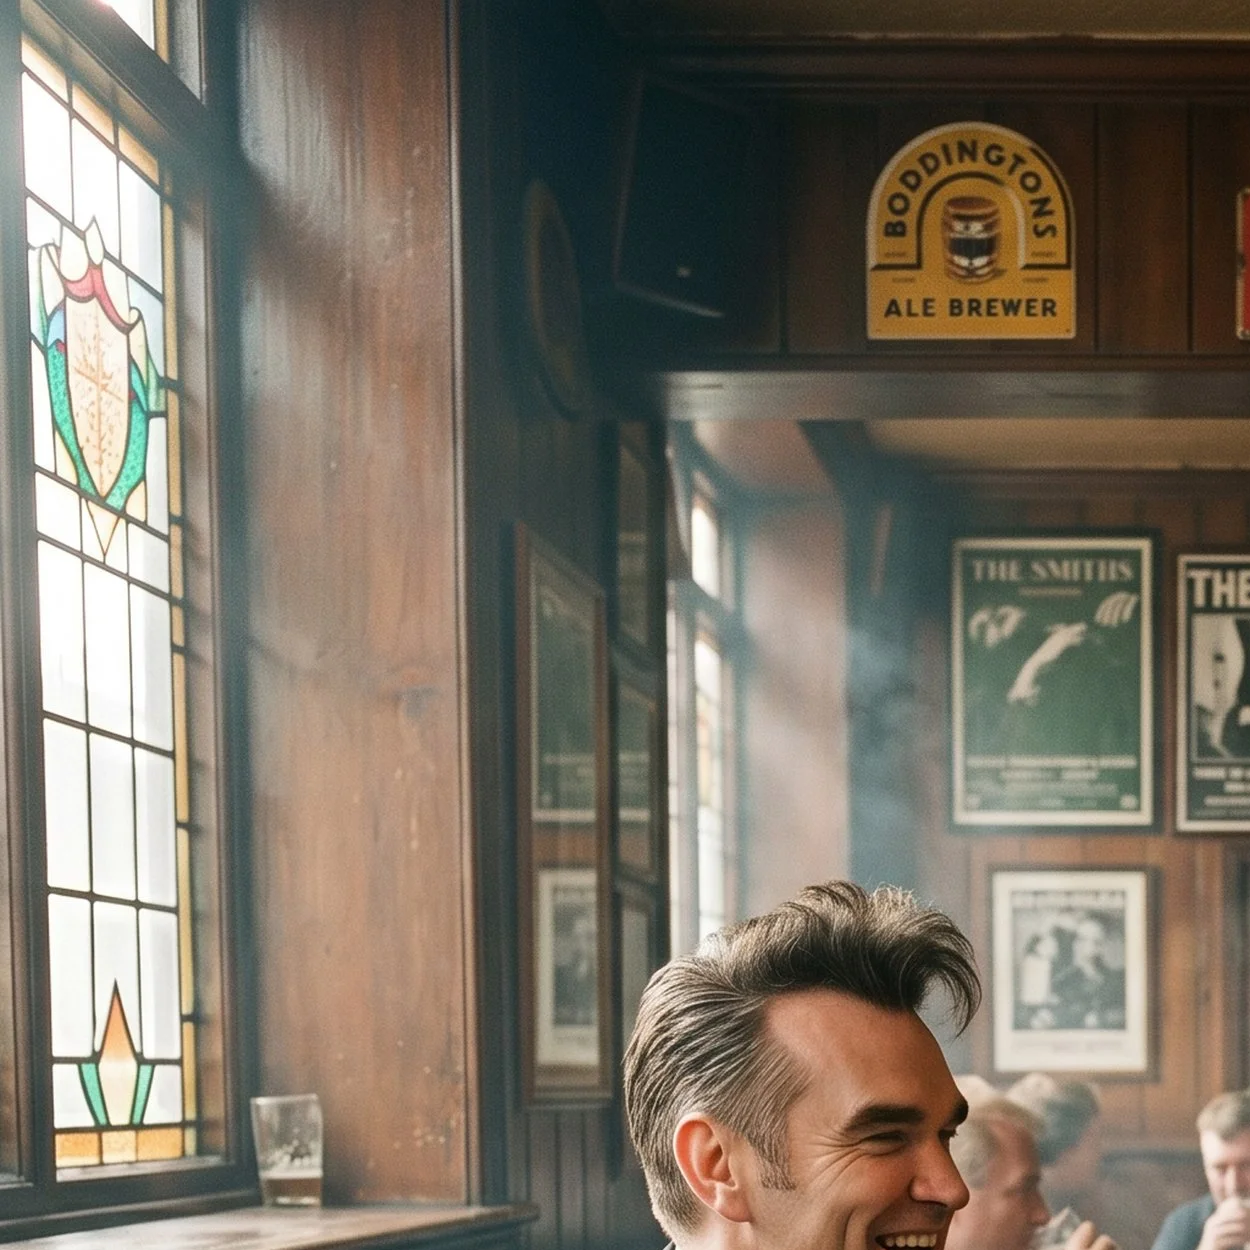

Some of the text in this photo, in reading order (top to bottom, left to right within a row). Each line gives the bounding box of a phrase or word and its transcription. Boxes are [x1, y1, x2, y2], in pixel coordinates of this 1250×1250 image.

[883, 139, 1057, 238] BODDINGTONS
[884, 298, 1057, 318] ALE BREWER
[974, 559, 1020, 582] THE
